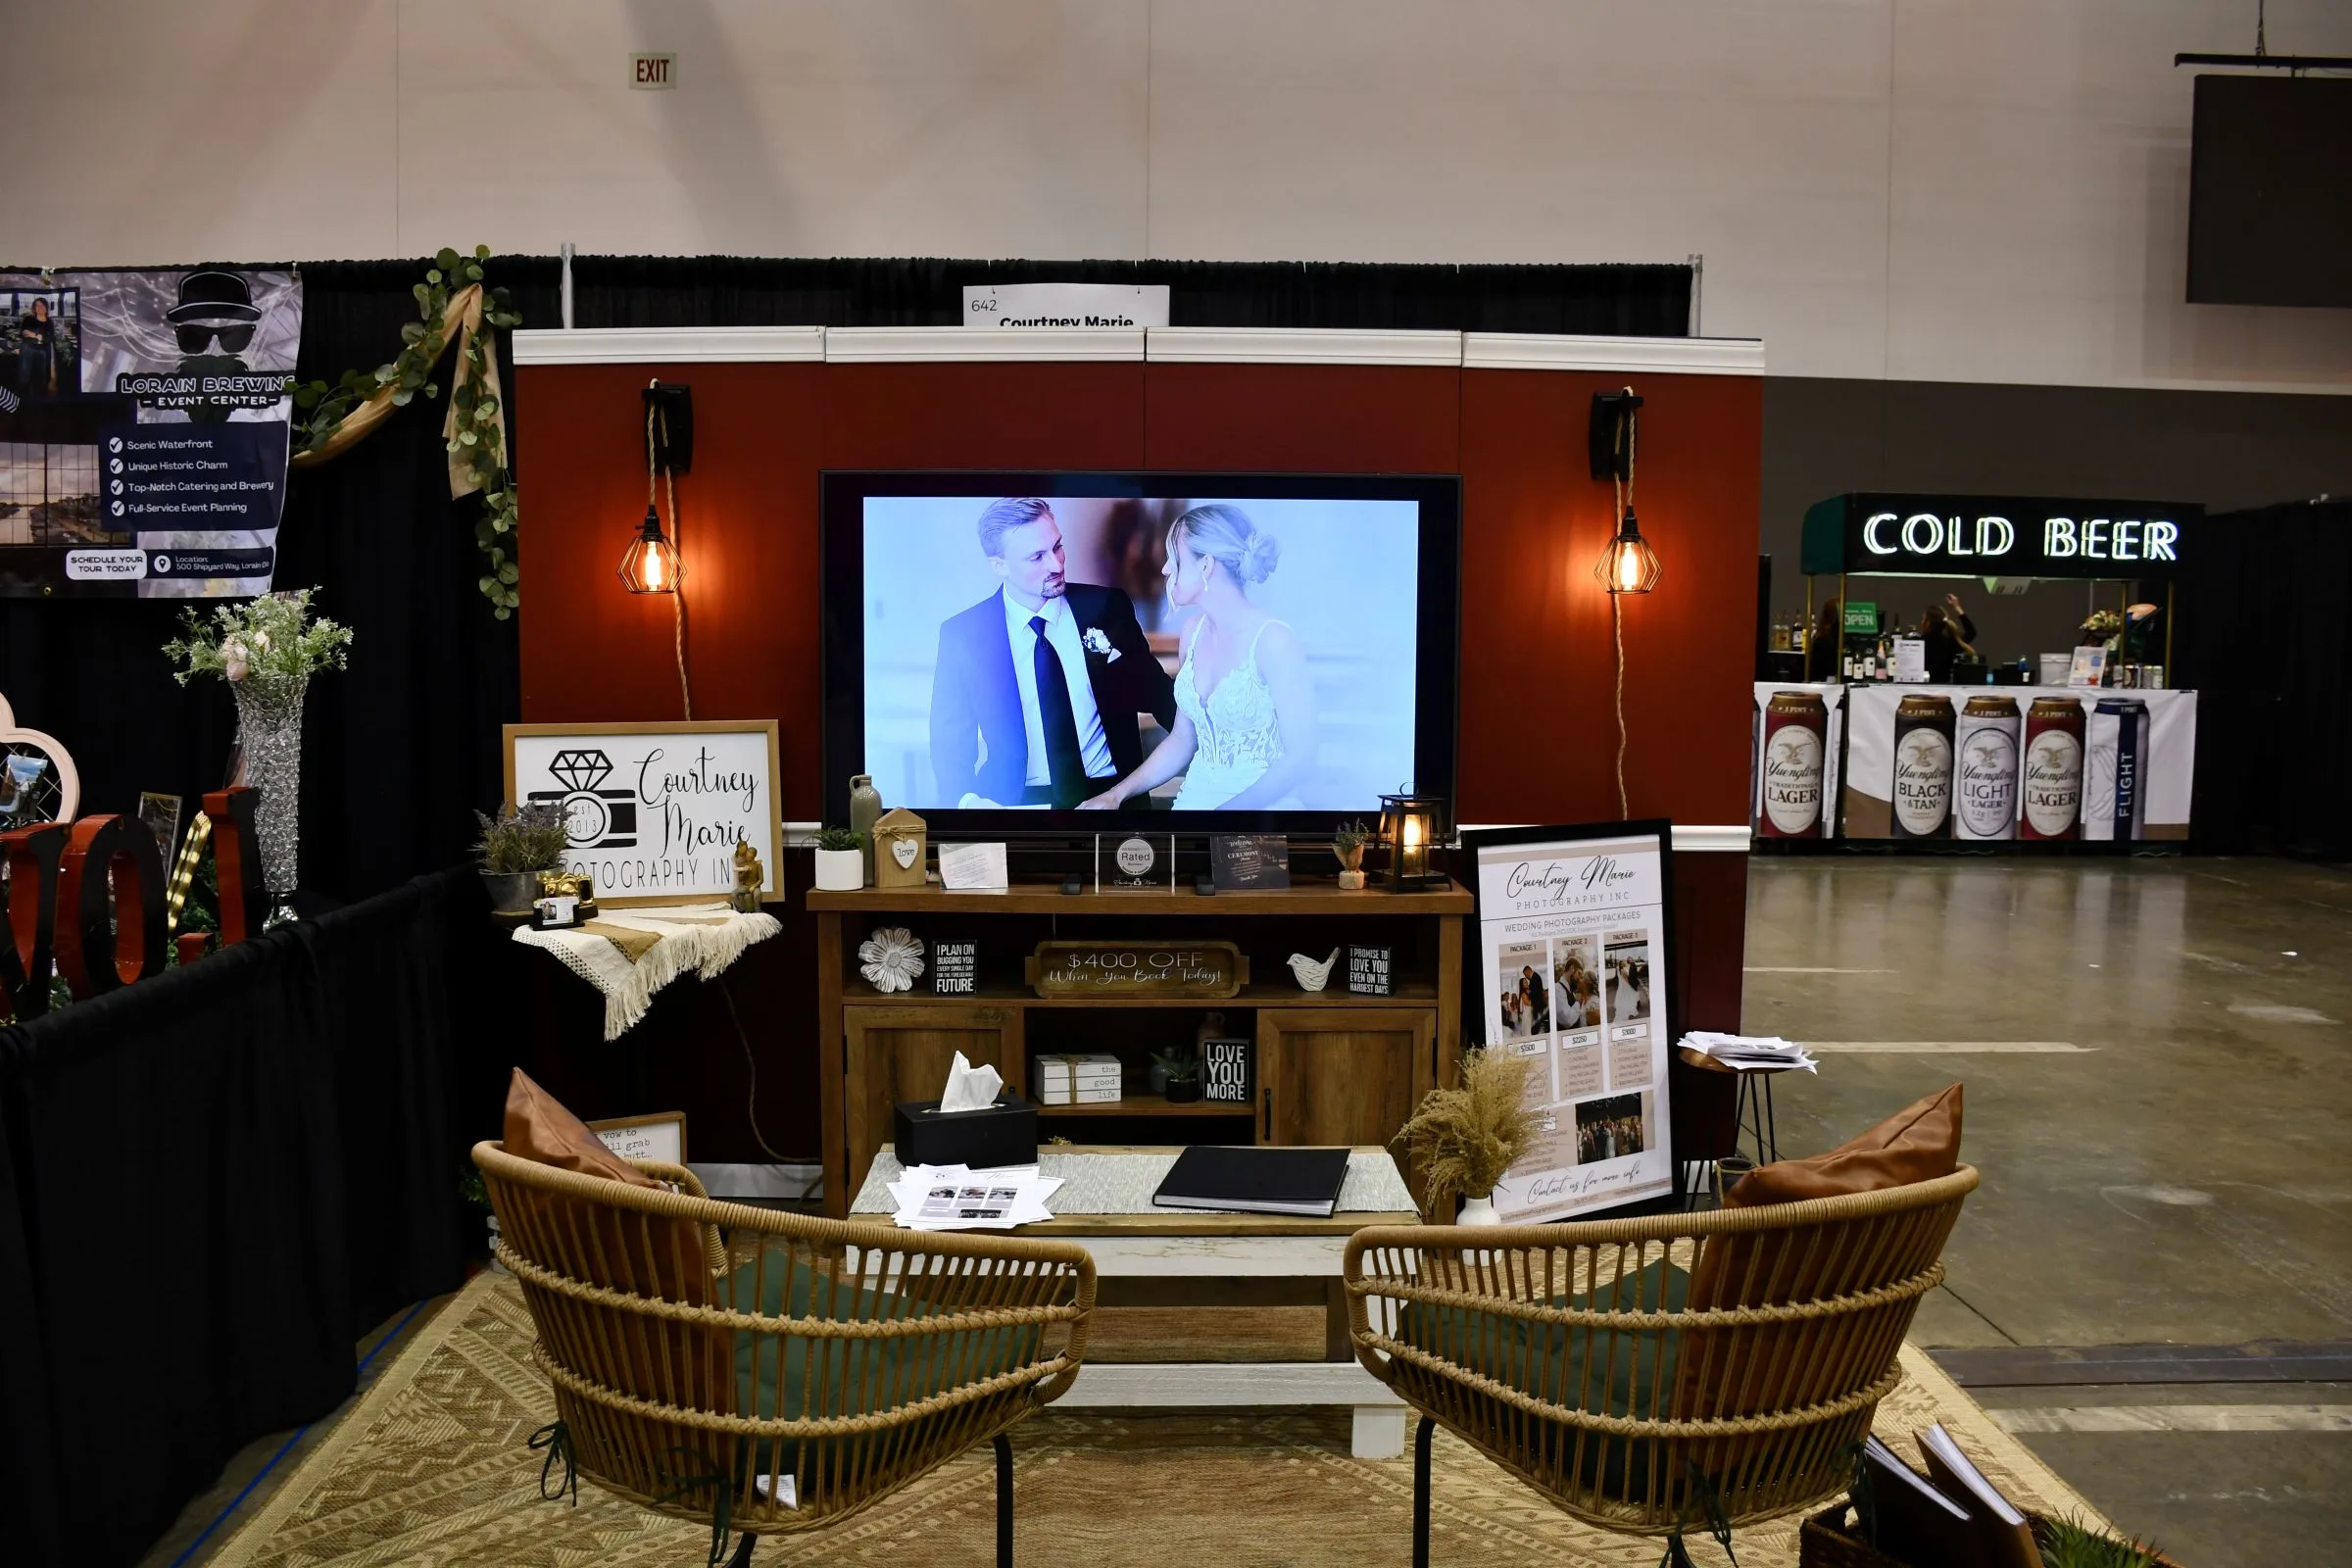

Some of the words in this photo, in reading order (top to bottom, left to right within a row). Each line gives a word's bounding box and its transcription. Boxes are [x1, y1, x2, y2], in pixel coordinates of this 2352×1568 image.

[637, 59, 669, 82] EXIT
[971, 299, 998, 313] 642
[1085, 315, 1134, 326] Marie
[122, 377, 196, 394] LORAIN
[158, 396, 204, 406] EVENT
[211, 395, 268, 406] CENTER
[127, 441, 156, 450] Scenic
[158, 440, 214, 449] Waterfront
[127, 463, 158, 472] Unique
[160, 462, 194, 470] Historic
[196, 461, 227, 469] Charm
[128, 483, 176, 493] Top-Notch
[177, 482, 219, 492] Catering
[239, 481, 274, 490] Brewery
[128, 504, 179, 513] Full-Service
[210, 503, 247, 514] Planning
[1863, 513, 2015, 556] COLD
[2043, 517, 2179, 562] BEER
[193, 563, 223, 572] Shipyard
[1844, 614, 1874, 626] OPEN
[633, 746, 760, 813] Courtney
[2119, 753, 2132, 817] FLIGHT
[1768, 787, 1818, 804] LAGER
[1899, 782, 1946, 798] BLACK
[1964, 782, 2011, 799] LIGHT
[1913, 800, 1936, 809] TAN
[1971, 800, 2002, 808] LAGER
[2028, 790, 2077, 807] LAGER
[574, 804, 591, 815] est
[568, 819, 597, 833] 2013
[647, 795, 752, 858] Marie
[897, 848, 915, 858] love
[1121, 852, 1151, 861] Rated
[563, 858, 698, 889] OTOGRAPHY
[712, 858, 730, 885] IN
[1506, 862, 1573, 900] Courtney
[1580, 855, 1636, 890] Marie
[1516, 893, 1604, 910] PHOTOGRAPHY
[1609, 891, 1630, 902] INC
[1504, 921, 1543, 932] WEDDING
[1544, 915, 1601, 929] PHOTOGRAPHY
[1602, 910, 1642, 922] PACKAGES
[941, 944, 961, 956] PLAN
[963, 944, 975, 956] ON
[1354, 949, 1379, 958] PROMISE
[1381, 951, 1388, 959] TO
[937, 956, 961, 965] BUGGING
[962, 956, 974, 964] YOU
[1068, 953, 1137, 968] $400
[1149, 952, 1203, 967] OFF
[1350, 958, 1369, 972] LOVE
[1372, 959, 1388, 973] YOU
[1050, 968, 1089, 983] When
[1097, 969, 1129, 985] You
[1134, 968, 1170, 983] Book
[1177, 967, 1221, 986] Today!
[1350, 972, 1365, 982] EVEN
[1367, 973, 1375, 983] ON
[1377, 974, 1388, 984] THE
[936, 978, 974, 993] FUTURE
[1350, 983, 1373, 993] HARDEST
[1375, 985, 1388, 994] DAYS
[1572, 1035, 1588, 1045] $2250
[1206, 1044, 1246, 1063] LOVE
[1206, 1061, 1246, 1085] YOU
[1094, 1078, 1115, 1087] good
[1098, 1091, 1115, 1100] life
[1206, 1083, 1246, 1101] MORE
[625, 1138, 651, 1152] grab
[1527, 1174, 1573, 1203] Contact
[1569, 1182, 1579, 1193] us
[1582, 1170, 1597, 1193] for
[1601, 1174, 1619, 1183] more
[1623, 1160, 1640, 1183] info
